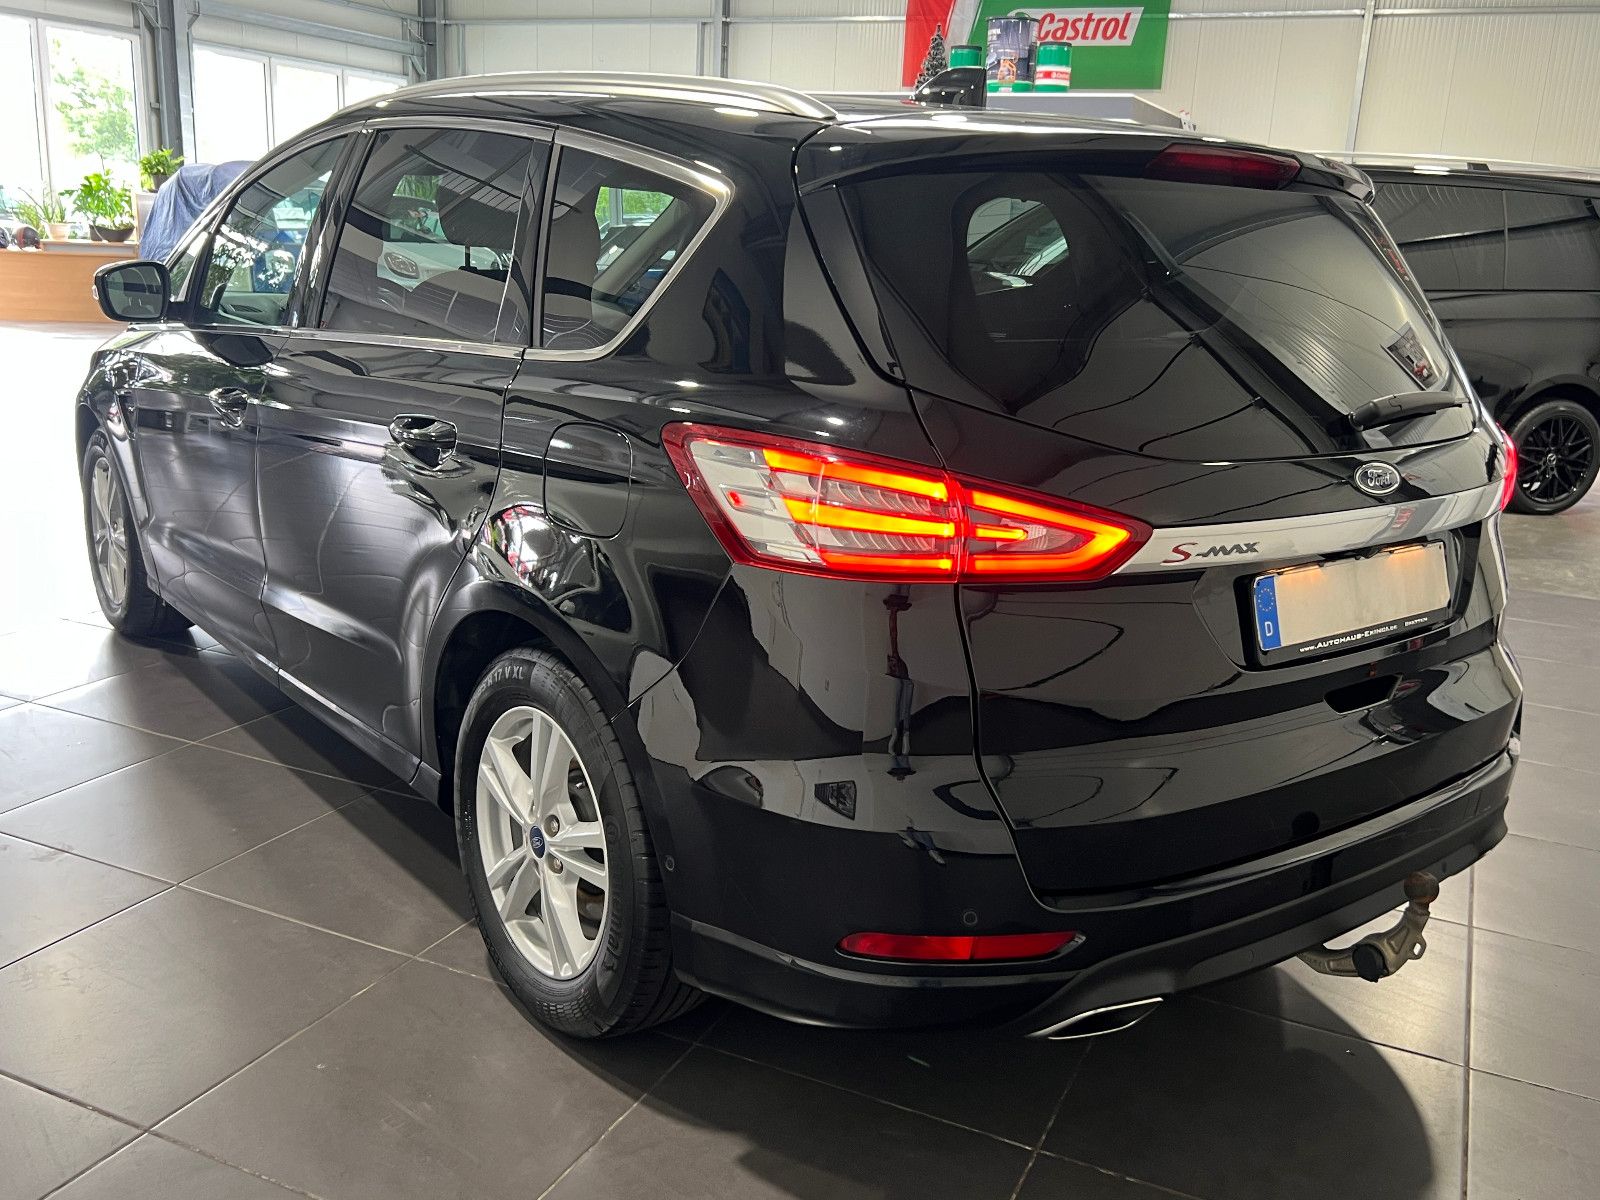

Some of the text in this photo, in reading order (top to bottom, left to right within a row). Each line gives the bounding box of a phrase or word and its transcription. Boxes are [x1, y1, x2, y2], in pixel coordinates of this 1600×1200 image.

[1037, 12, 1132, 41] Castrol
[1161, 541, 1260, 564] S-MAX
[1265, 621, 1273, 636] D
[512, 666, 524, 680] XL
